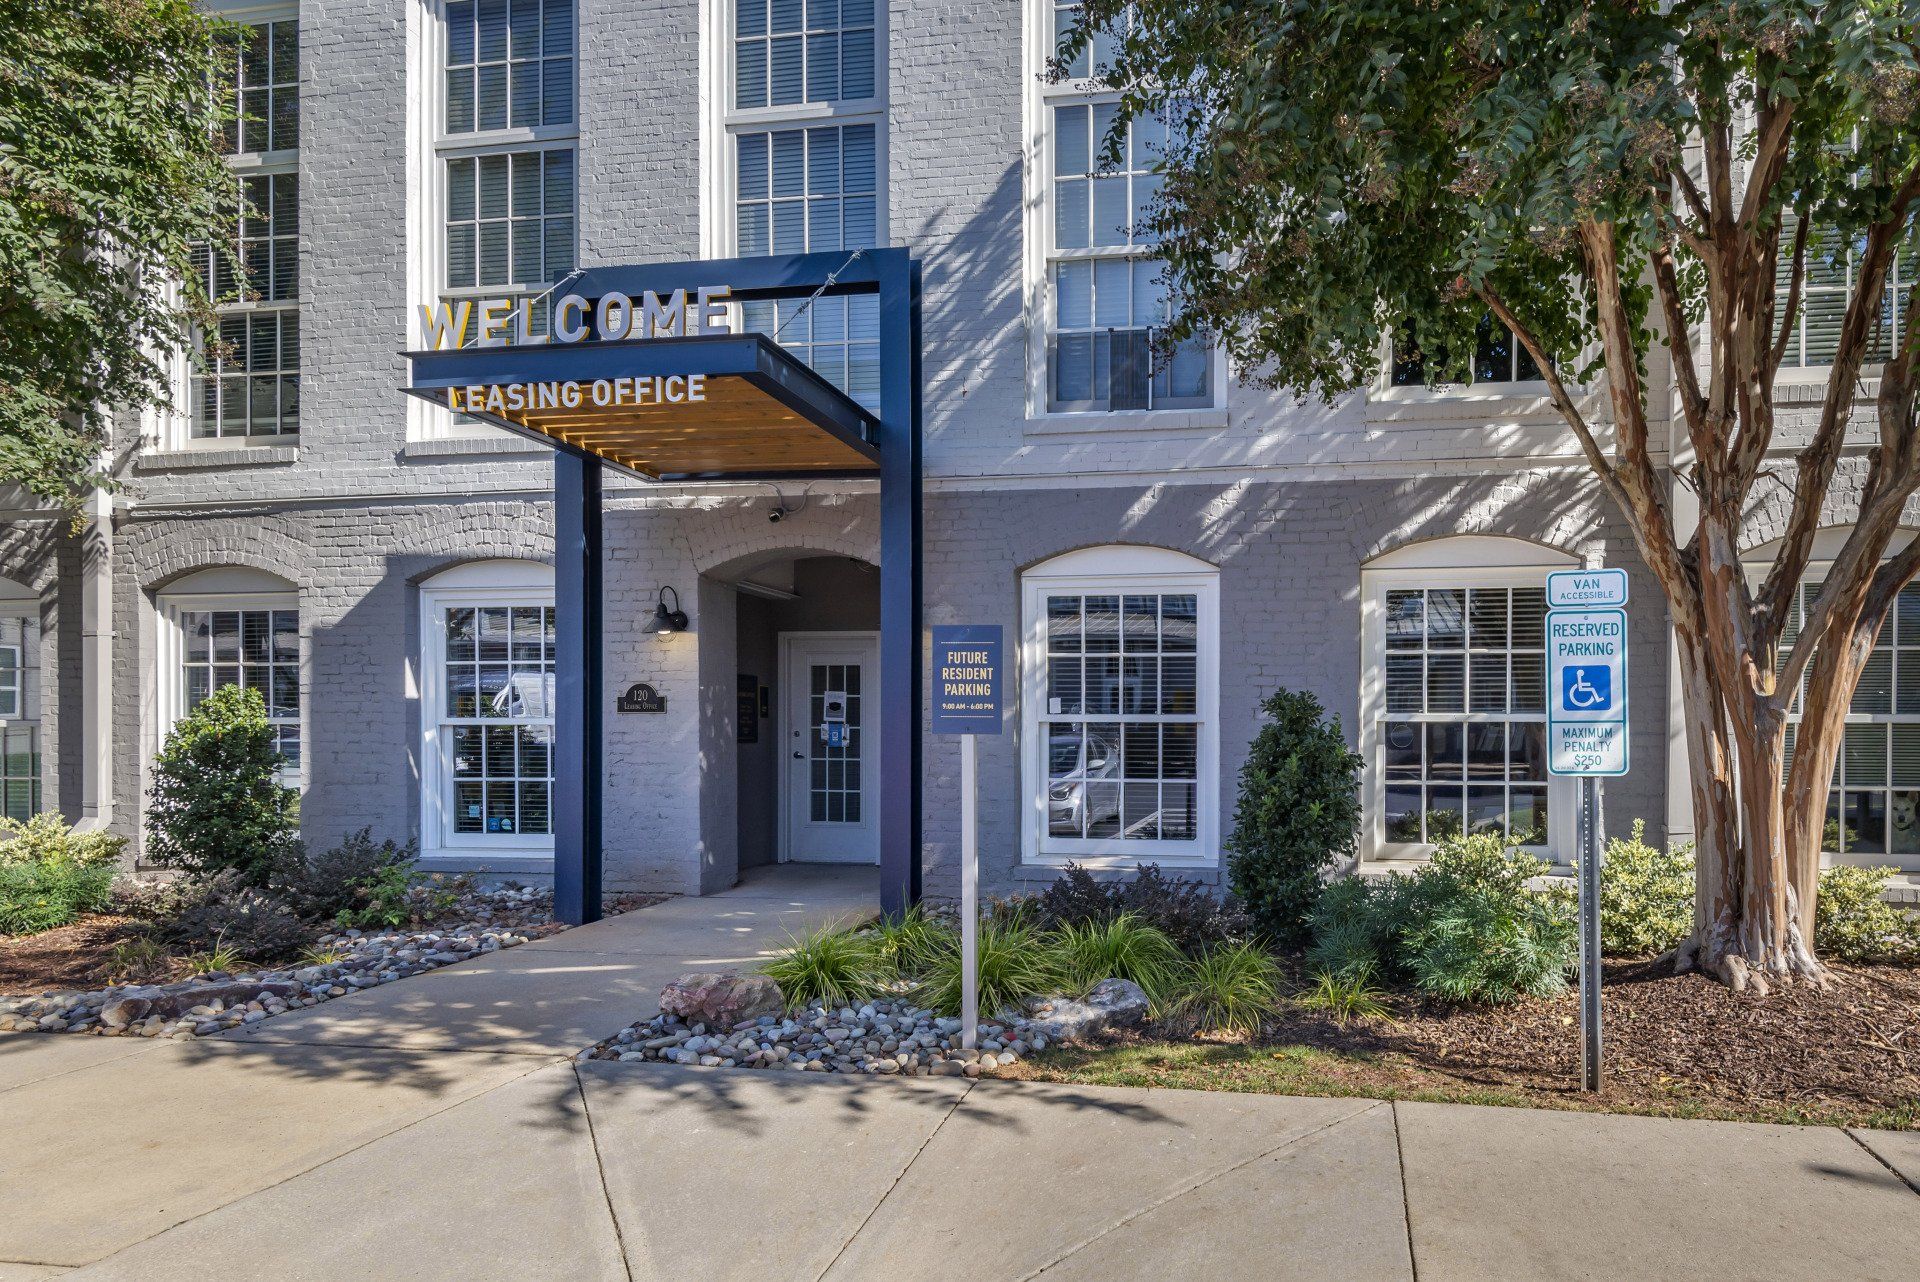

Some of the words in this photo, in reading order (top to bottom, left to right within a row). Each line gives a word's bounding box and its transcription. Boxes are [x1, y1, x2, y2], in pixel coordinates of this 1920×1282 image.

[417, 285, 731, 350] WELCOME
[448, 381, 583, 412] LEASING
[592, 374, 708, 406] OFFICE
[1573, 578, 1600, 590] VAN
[1560, 590, 1614, 600] ACCESSIBLE
[1553, 622, 1619, 638] RESERVED
[1558, 642, 1614, 656] PARKING
[947, 651, 988, 664] FUTURE
[942, 667, 993, 680] RESIDENT
[633, 689, 648, 701] 120
[944, 683, 991, 696] PARKING
[1562, 727, 1613, 738] MAXIMUM
[1564, 741, 1612, 752] PENALTY
[1574, 754, 1602, 767] $250
